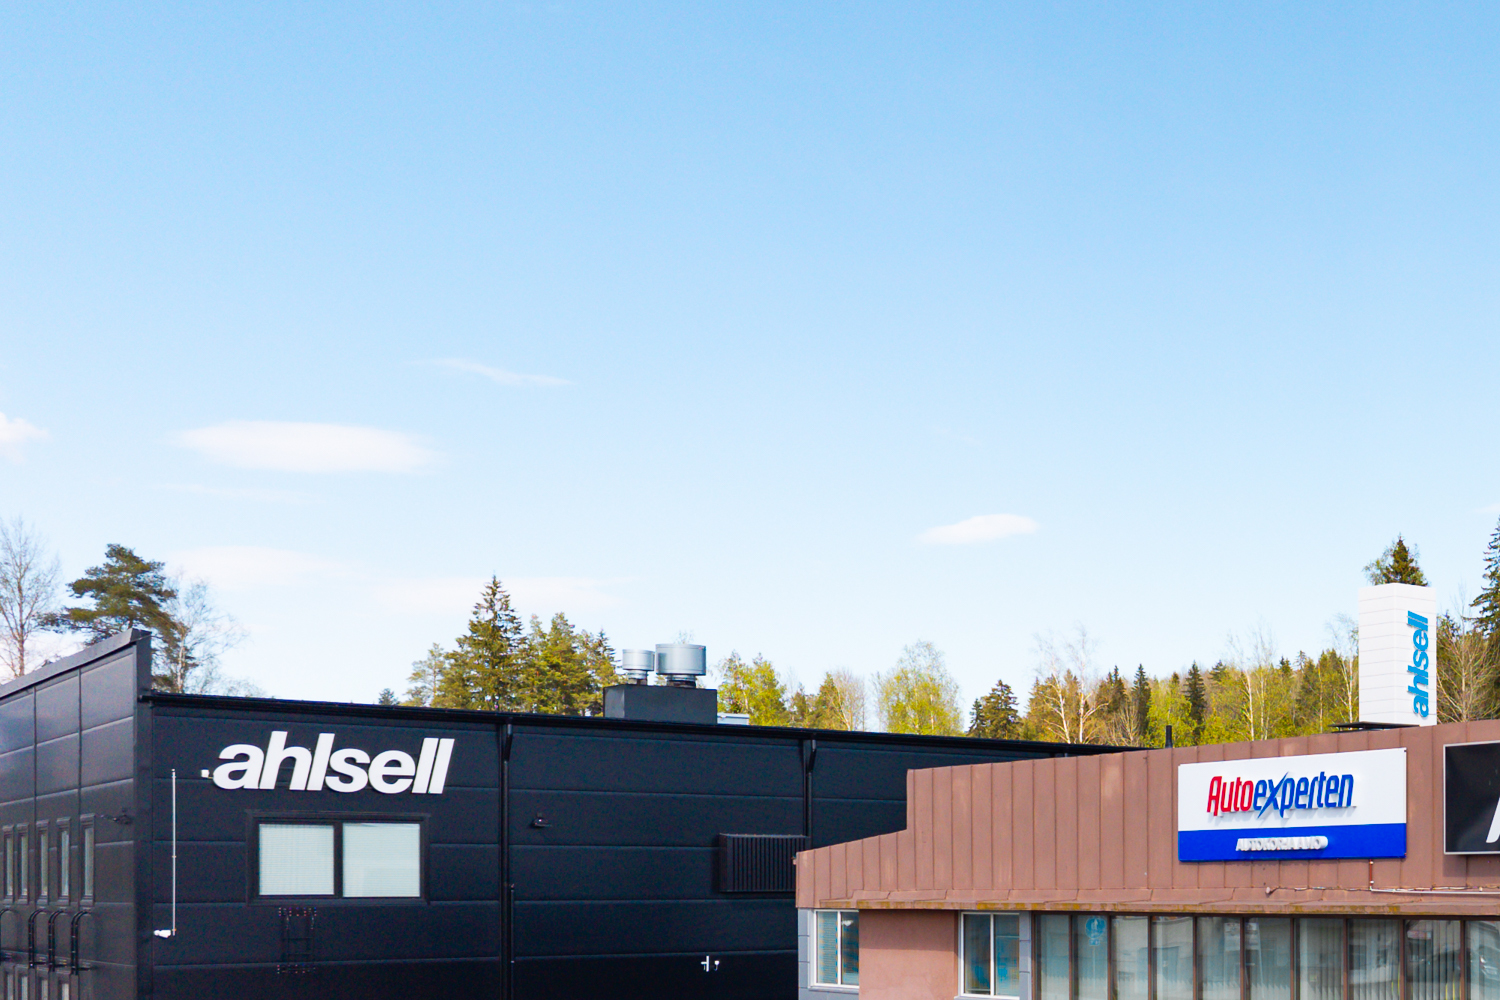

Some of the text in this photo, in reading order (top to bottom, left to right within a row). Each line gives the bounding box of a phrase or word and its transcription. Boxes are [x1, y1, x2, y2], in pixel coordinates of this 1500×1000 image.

[1407, 610, 1429, 717] ahlsell
[212, 731, 455, 794] ahlsell
[1207, 771, 1354, 818] Autoexperten
